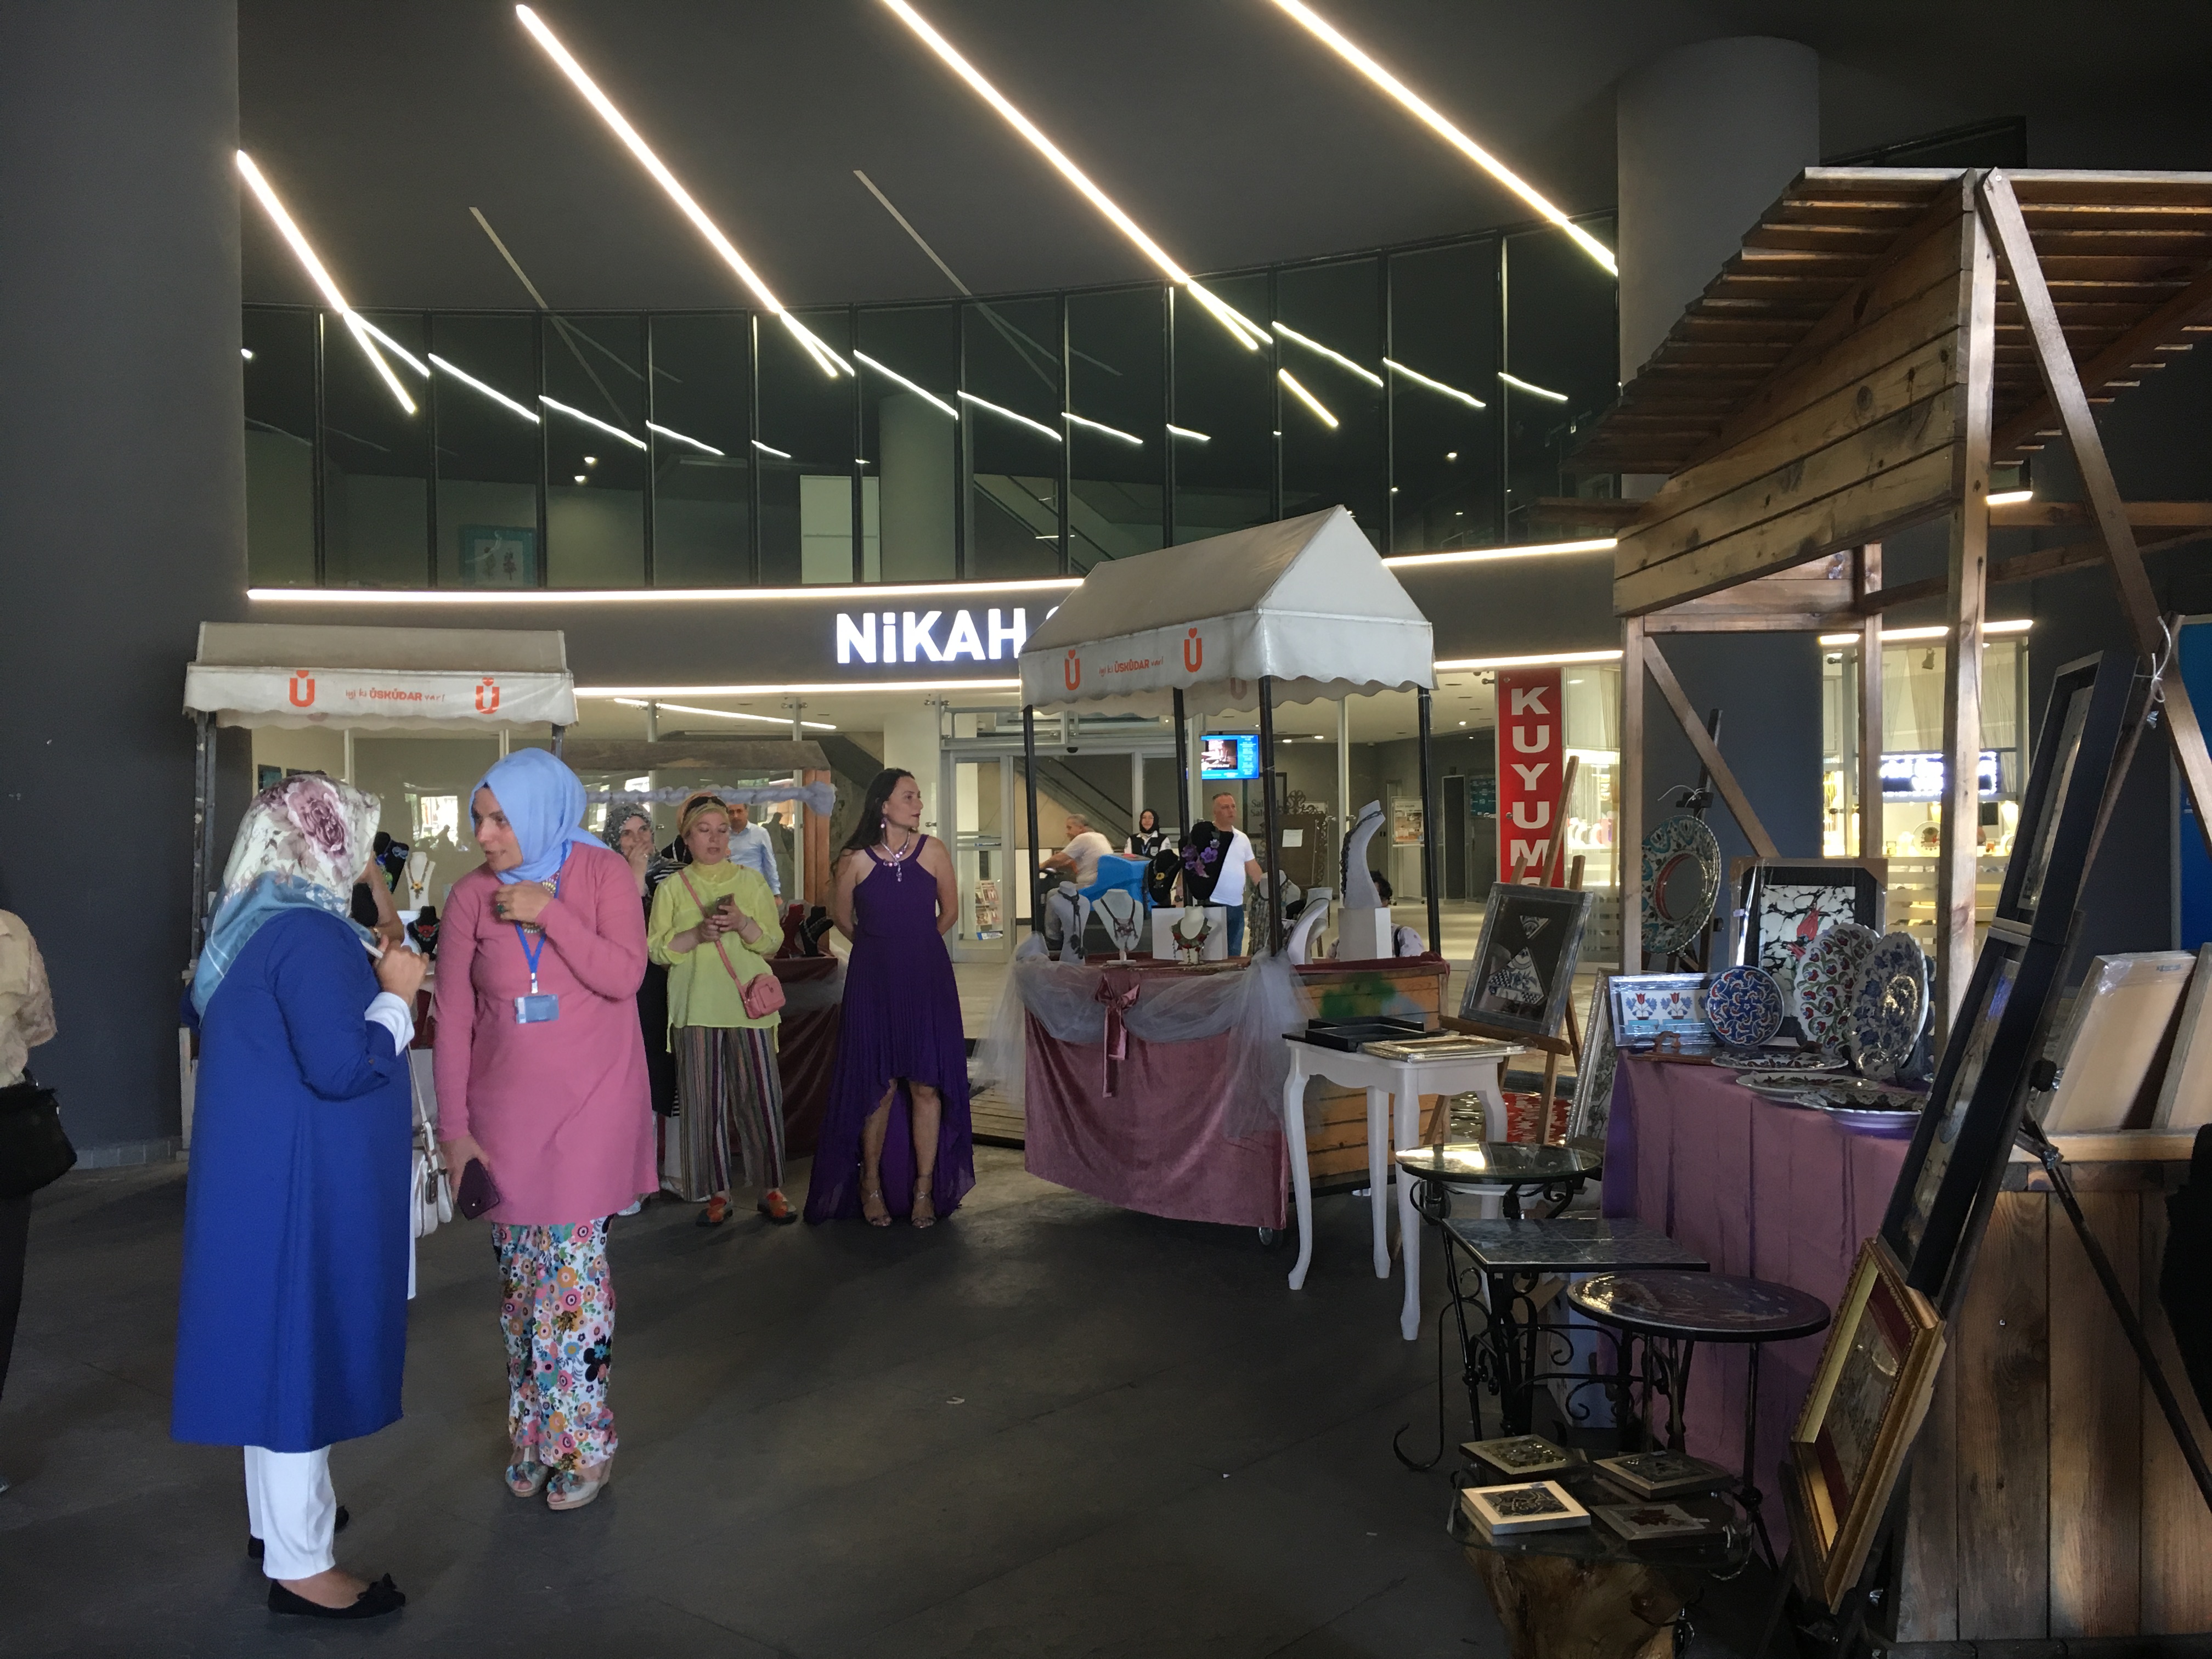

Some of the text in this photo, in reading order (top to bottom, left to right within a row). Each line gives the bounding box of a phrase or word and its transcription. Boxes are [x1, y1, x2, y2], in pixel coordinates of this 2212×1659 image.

[1114, 659, 1150, 673] ÜSKÜDAR
[369, 687, 422, 701] ÜSKÜDAR
[1510, 686, 1550, 884] KUYUM
